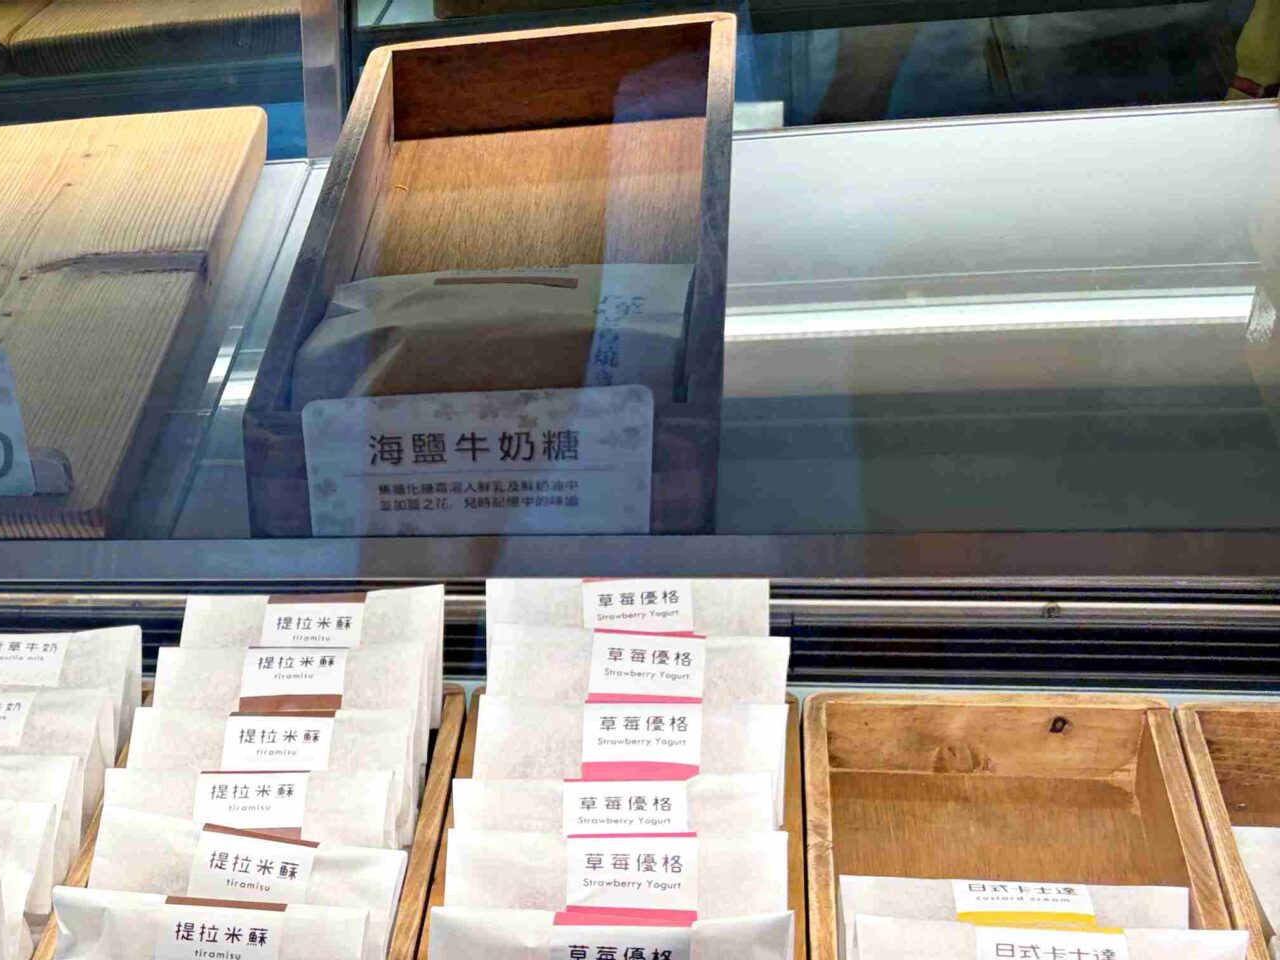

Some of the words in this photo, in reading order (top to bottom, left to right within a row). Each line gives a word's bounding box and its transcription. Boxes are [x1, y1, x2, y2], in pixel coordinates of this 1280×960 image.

[369, 429, 580, 466] 海鹽牛奶糖
[597, 590, 679, 607] 草莓優格
[596, 611, 646, 621] Strawberry
[649, 610, 679, 619] Yogurt
[276, 616, 353, 631] 提拉米蘇
[292, 634, 331, 642] tiramisu
[258, 655, 336, 670] 提拉米蘇
[607, 647, 693, 667] 草莓優格
[274, 672, 313, 680] tiramisu
[604, 667, 656, 680] Strawberry
[659, 671, 690, 681] Yogurt
[600, 716, 688, 732] 草莓優格
[239, 728, 321, 744] 提拉米蘇
[597, 737, 651, 747] Strawberry
[654, 737, 686, 747] Yogurt
[256, 748, 297, 756] tiramisu
[211, 783, 295, 800] 提拉米蘇
[228, 804, 271, 812] tiramisu
[579, 796, 672, 812] 草莓優格
[577, 816, 634, 825] Strawberry
[638, 817, 671, 826] Yogurt
[209, 851, 300, 880] 提拉米蘇
[584, 853, 683, 874] 草莓優格
[226, 878, 271, 892] tiramisu
[582, 878, 642, 890] Strawberry
[646, 880, 682, 891] Yogurt
[968, 883, 1078, 896] 日式卡士達
[175, 922, 269, 947] 提拉米蘇
[195, 949, 241, 960] tiramisu
